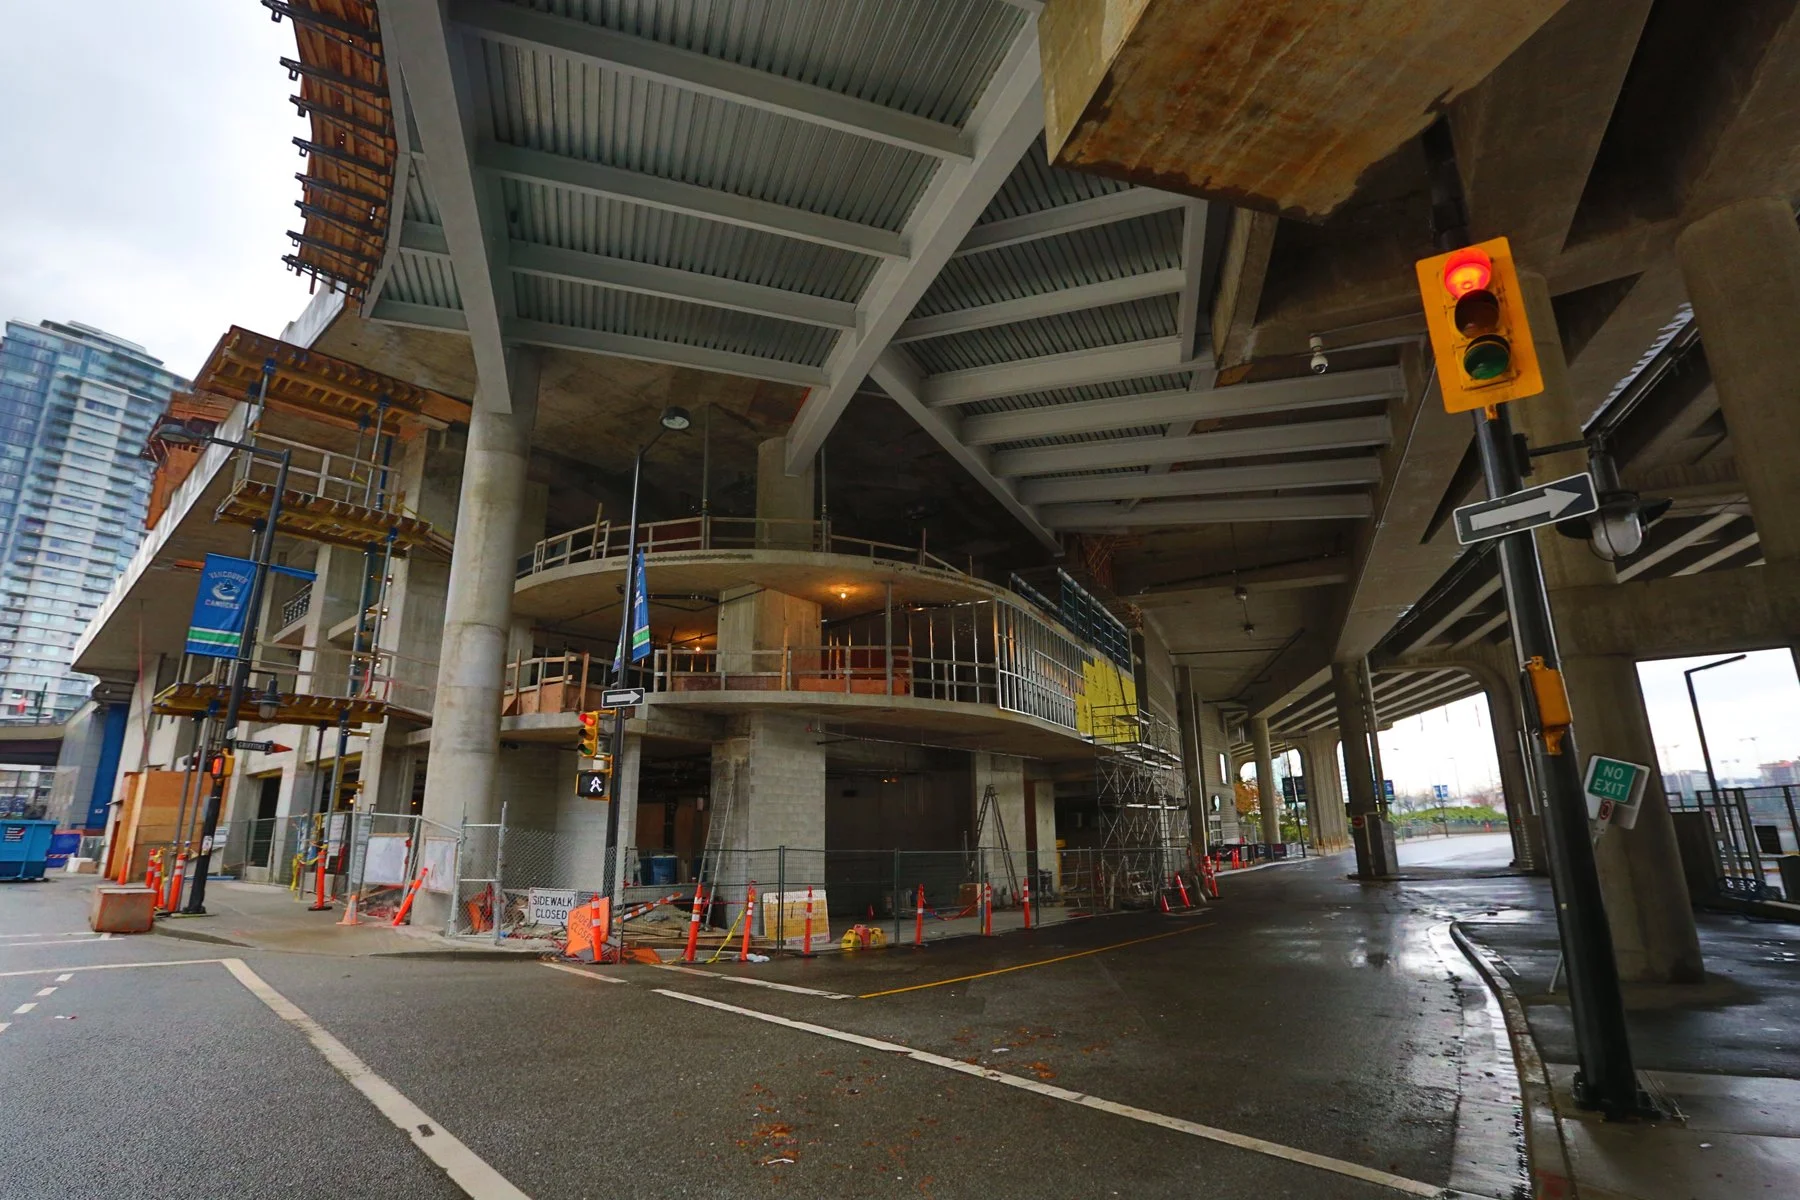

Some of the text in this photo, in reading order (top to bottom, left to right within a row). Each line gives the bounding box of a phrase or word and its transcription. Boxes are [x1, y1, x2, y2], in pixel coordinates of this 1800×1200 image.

[208, 571, 248, 584] VANCOUVER
[1603, 766, 1624, 780] NO
[1593, 778, 1625, 796] EXIT
[532, 896, 573, 907] SIDEWALK
[535, 909, 567, 920] CLOSED
[571, 922, 594, 941] CLOSE
